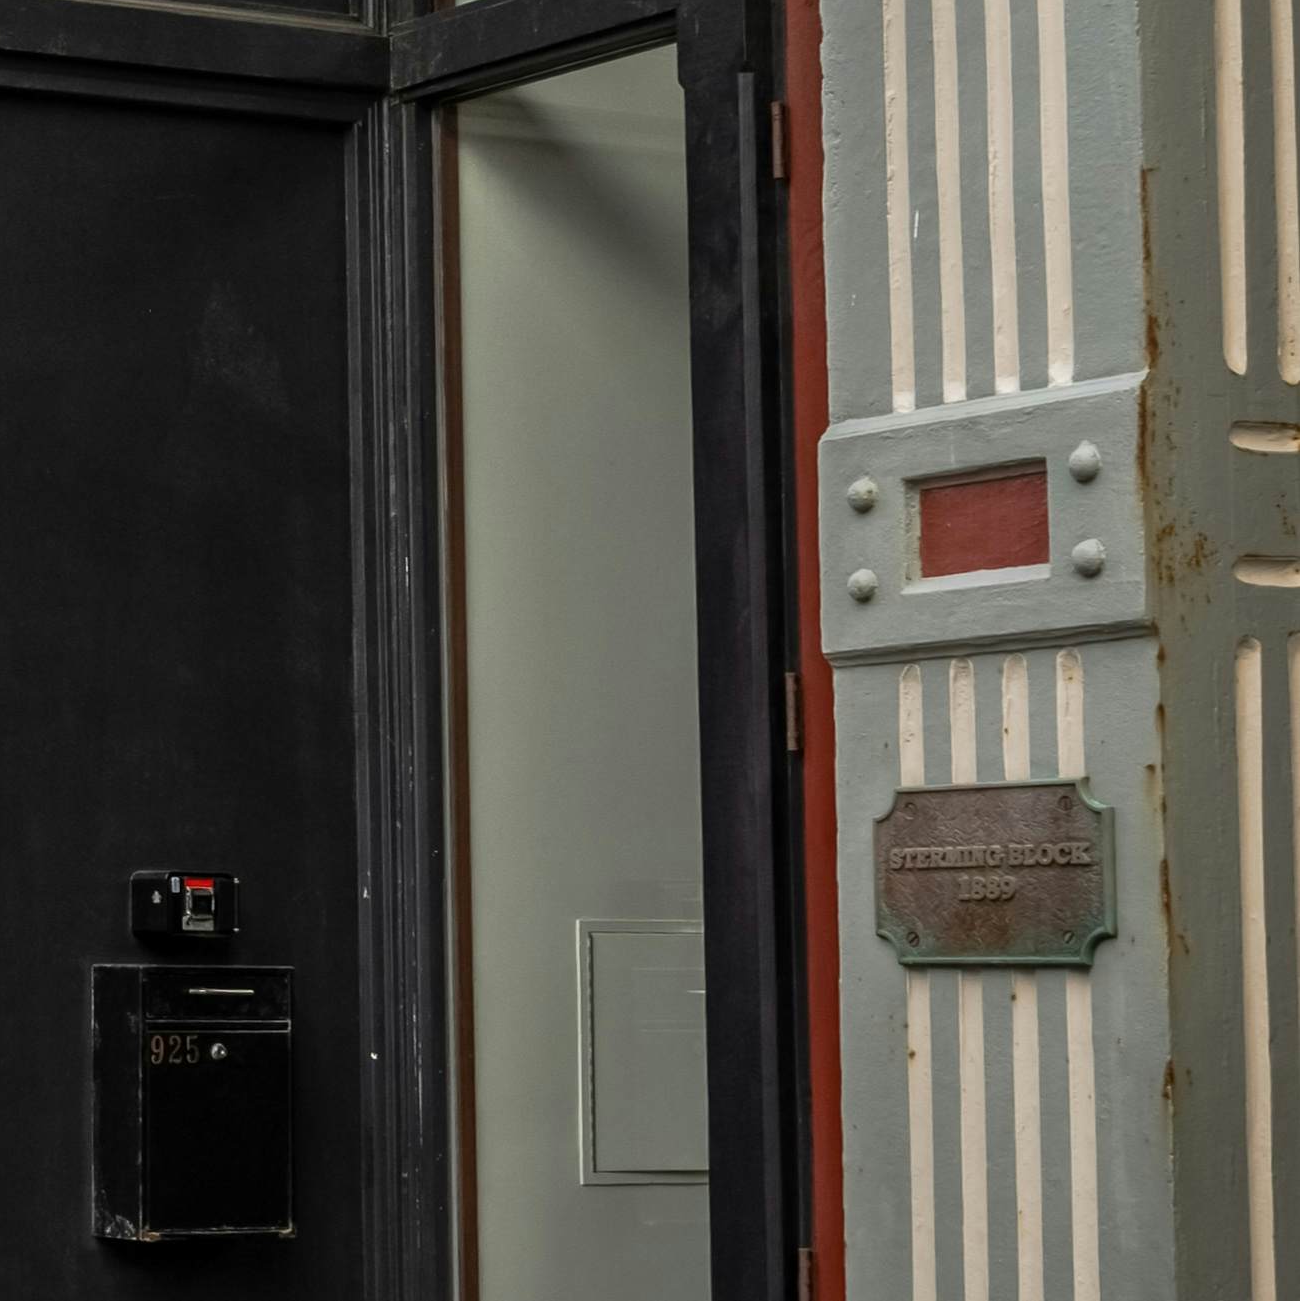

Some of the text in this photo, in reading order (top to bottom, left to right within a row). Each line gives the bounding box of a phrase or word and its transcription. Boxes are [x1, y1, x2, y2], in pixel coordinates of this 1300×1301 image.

[1007, 842, 1093, 867] BLOCK
[957, 875, 1018, 901] 1889
[151, 1035, 200, 1064] 925
